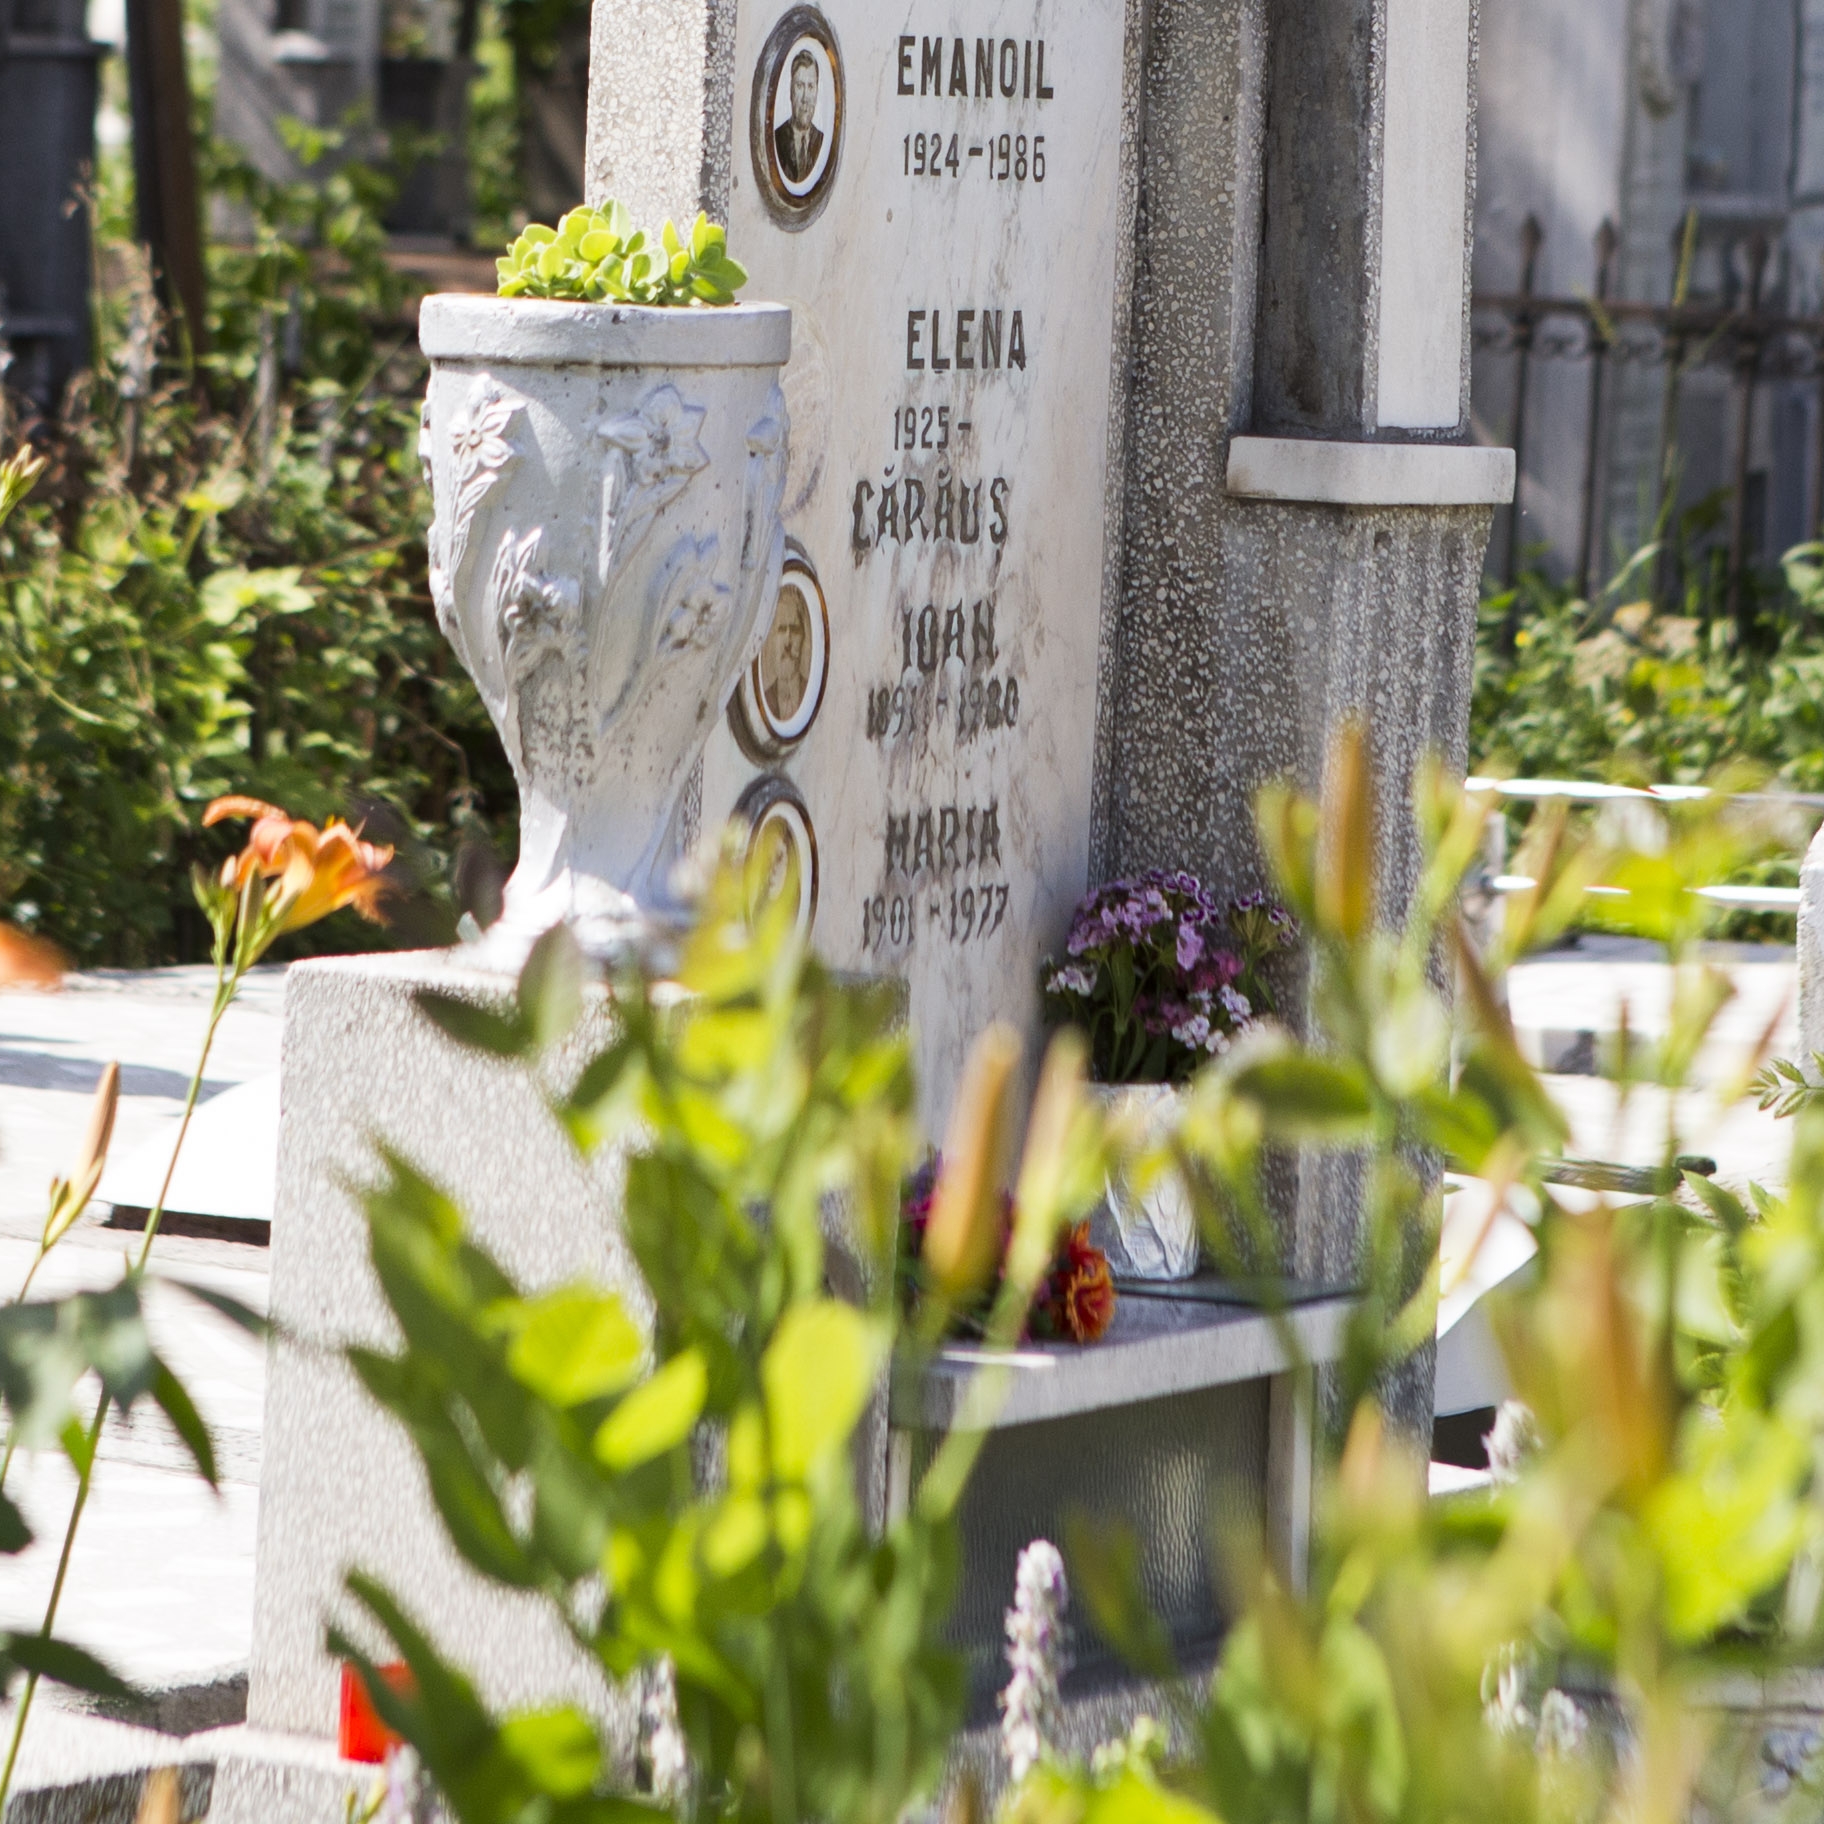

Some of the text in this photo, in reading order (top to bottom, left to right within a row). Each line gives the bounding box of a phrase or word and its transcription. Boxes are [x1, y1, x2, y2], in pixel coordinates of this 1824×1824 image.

[896, 35, 1054, 99] EMANOIL
[906, 309, 1026, 371] ELENA
[901, 599, 999, 675] IOAN
[885, 803, 1002, 879] MARIA
